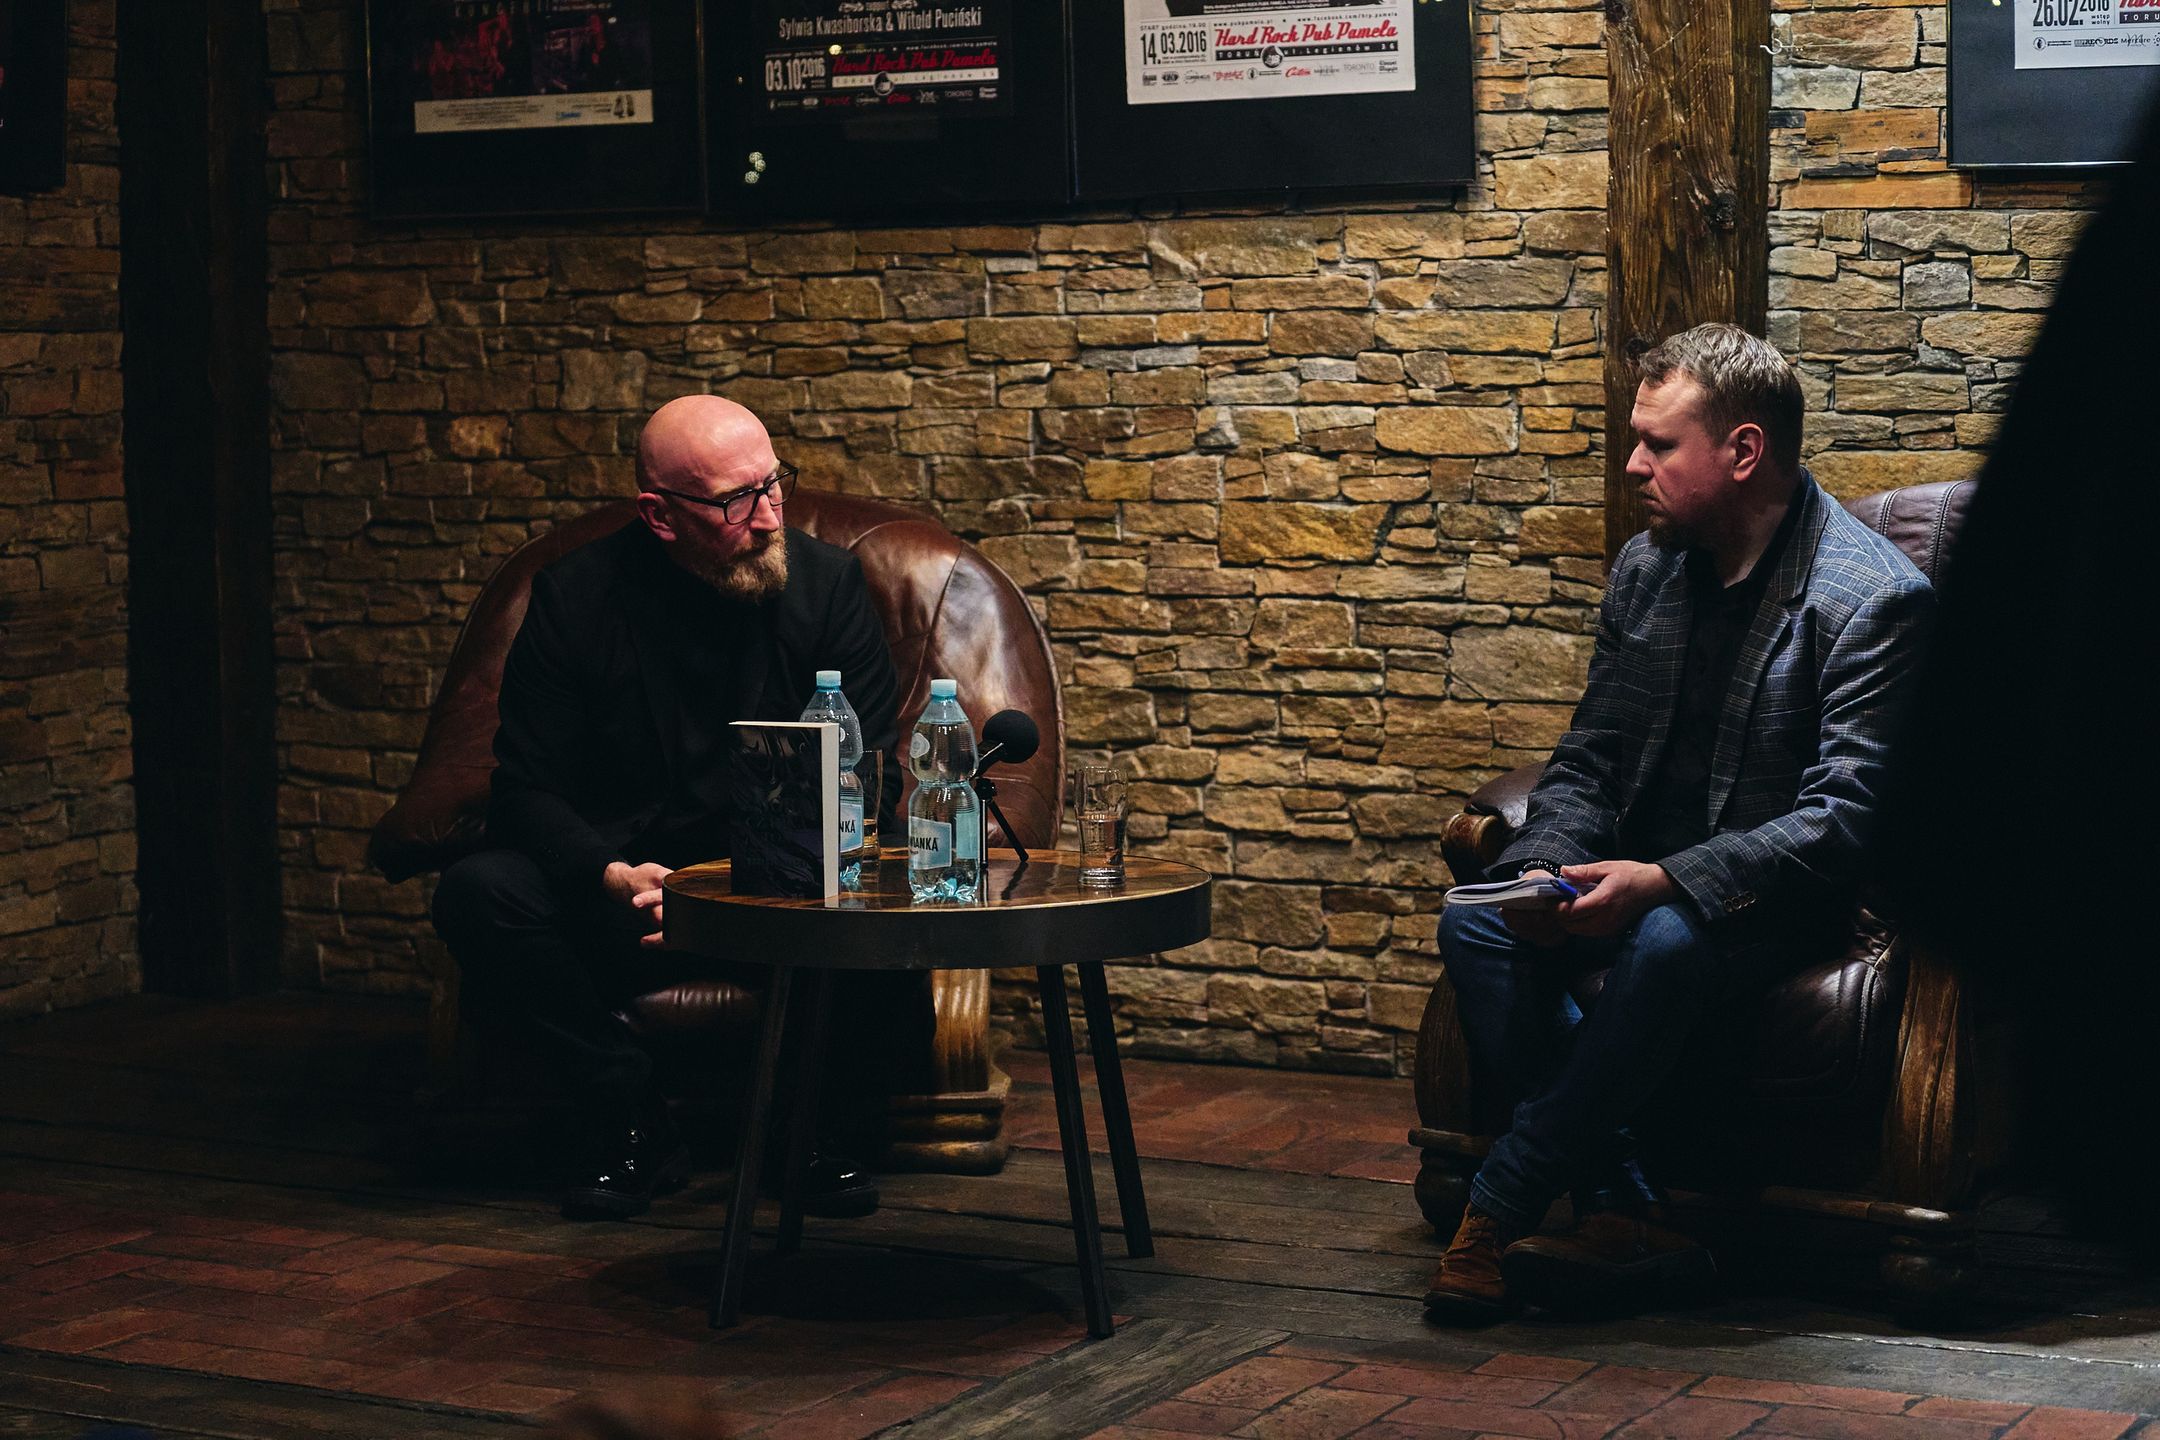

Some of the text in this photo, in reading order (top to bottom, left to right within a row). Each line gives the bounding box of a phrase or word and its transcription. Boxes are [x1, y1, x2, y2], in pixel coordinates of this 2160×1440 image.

[779, 6, 982, 40] Sylwia Kwasiborska & Witold Puciński
[1215, 19, 1398, 47] Hard Rock Pub Pamela
[873, 52, 907, 71] Rock
[912, 50, 938, 68] Pub
[941, 47, 998, 67] Pamela
[1219, 48, 1259, 58] TORUŃ
